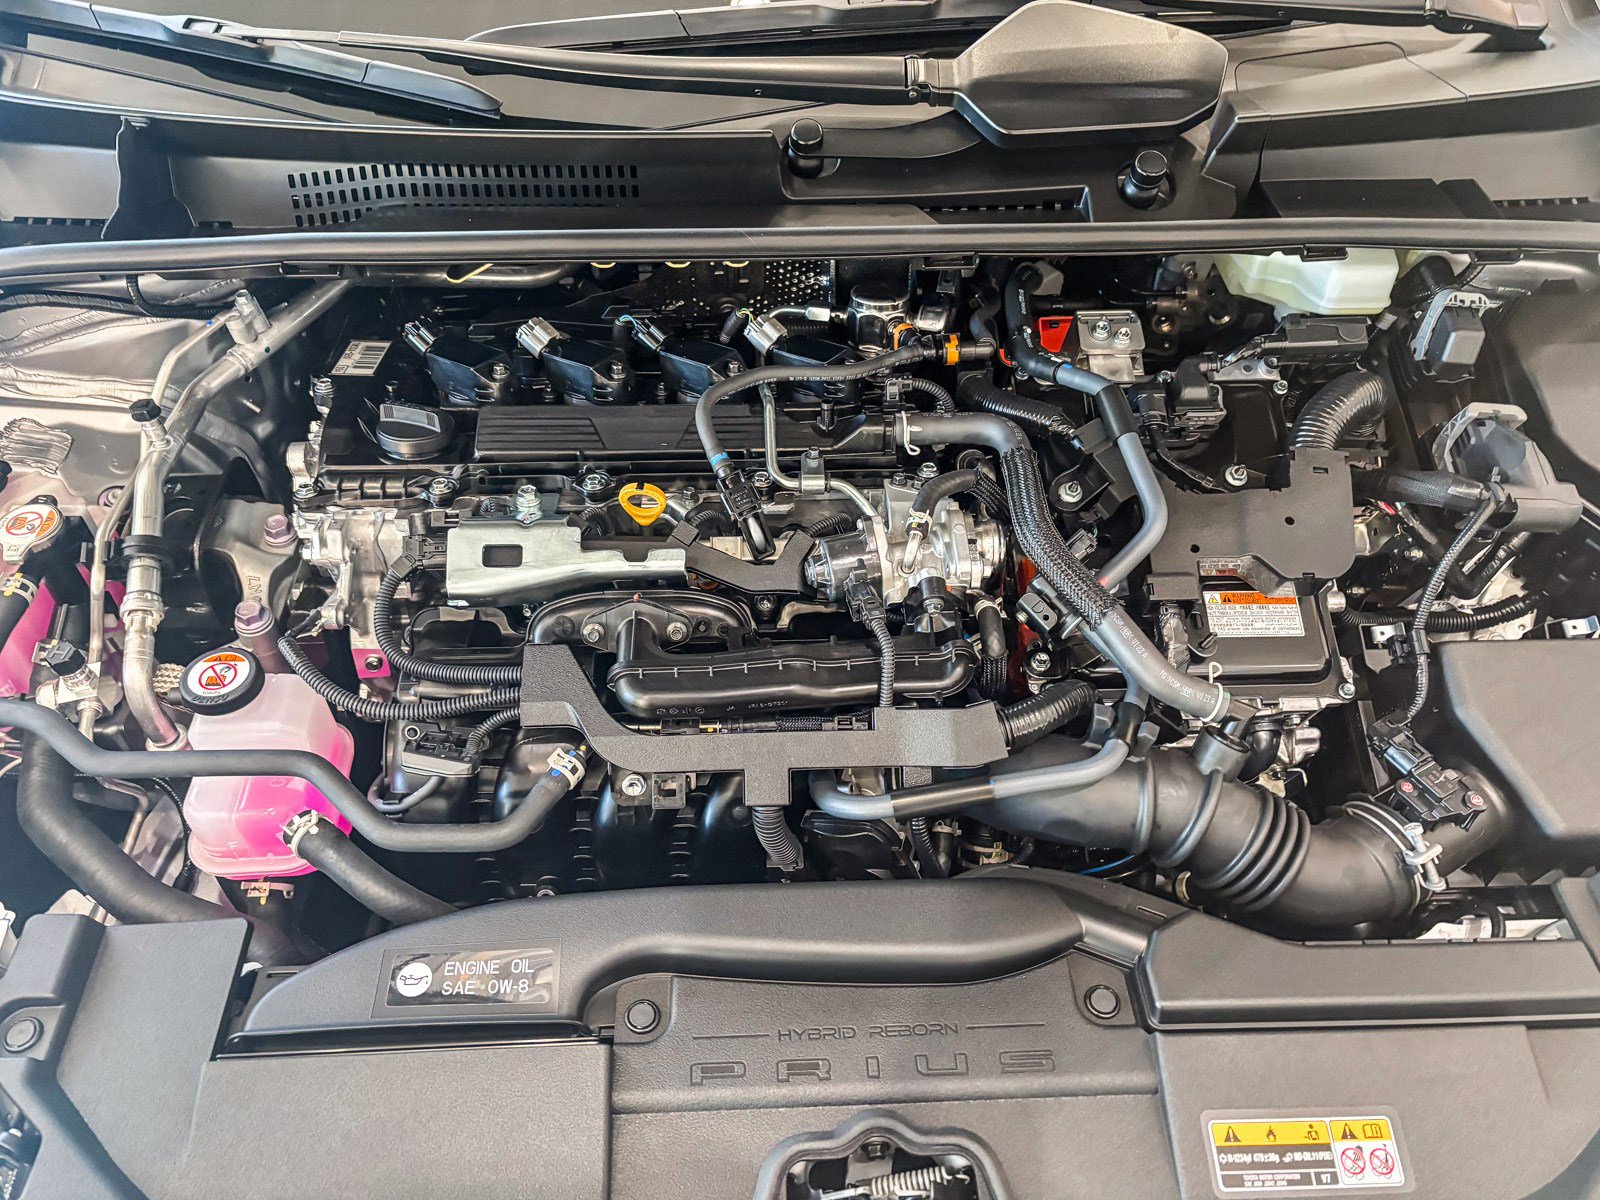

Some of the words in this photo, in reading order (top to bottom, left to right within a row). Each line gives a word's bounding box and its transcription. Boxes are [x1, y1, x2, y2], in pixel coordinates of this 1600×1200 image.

[444, 959, 501, 976] ENGINE
[510, 959, 535, 973] OIL
[441, 980, 475, 995] SAE
[487, 979, 529, 994] 0W-8
[777, 1026, 857, 1042] HYBRID
[869, 1022, 959, 1039] REBORN
[690, 1049, 1056, 1086] PRIUS
